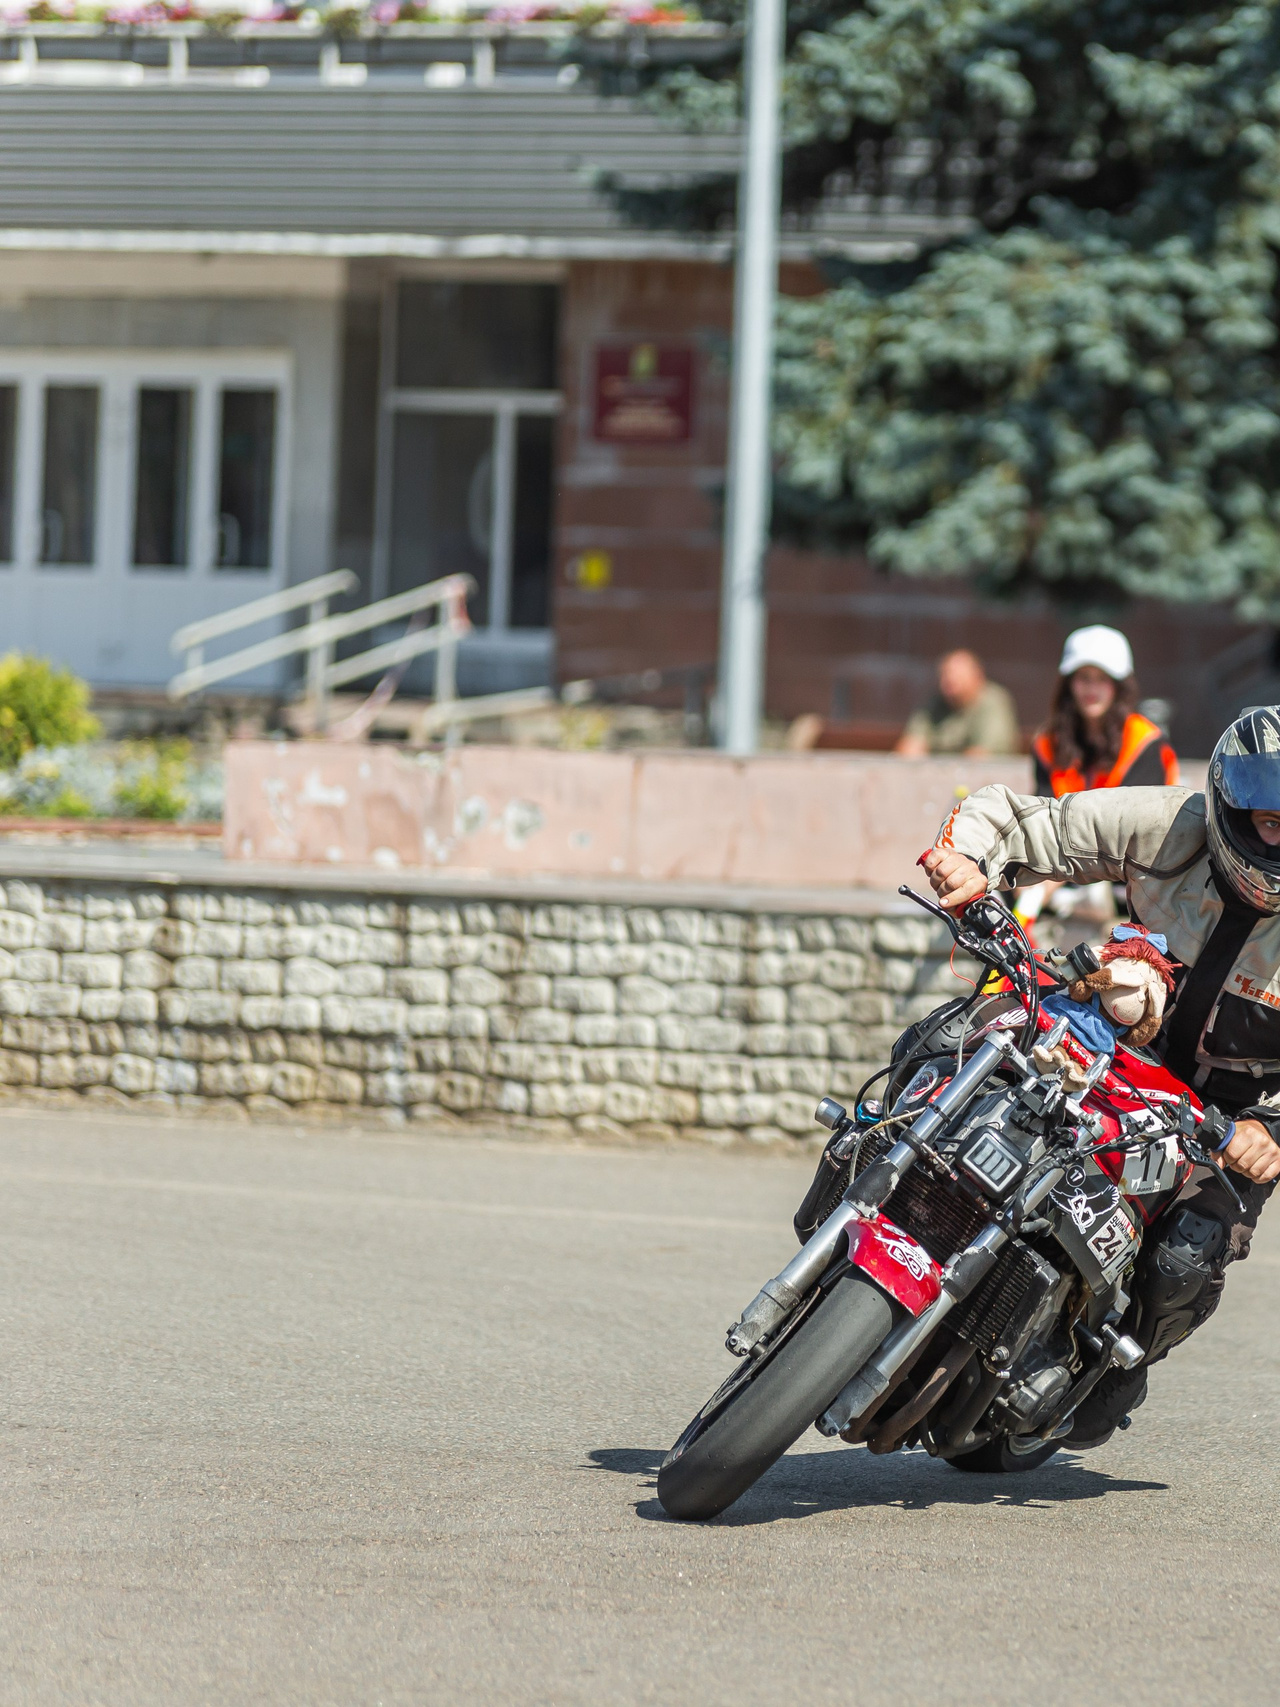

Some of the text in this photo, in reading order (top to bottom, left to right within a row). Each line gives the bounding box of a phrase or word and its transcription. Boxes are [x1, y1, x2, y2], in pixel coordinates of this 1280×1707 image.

[1069, 1169, 1083, 1182] 17
[1140, 1142, 1167, 1182] 17
[1091, 1225, 1123, 1262] 24
